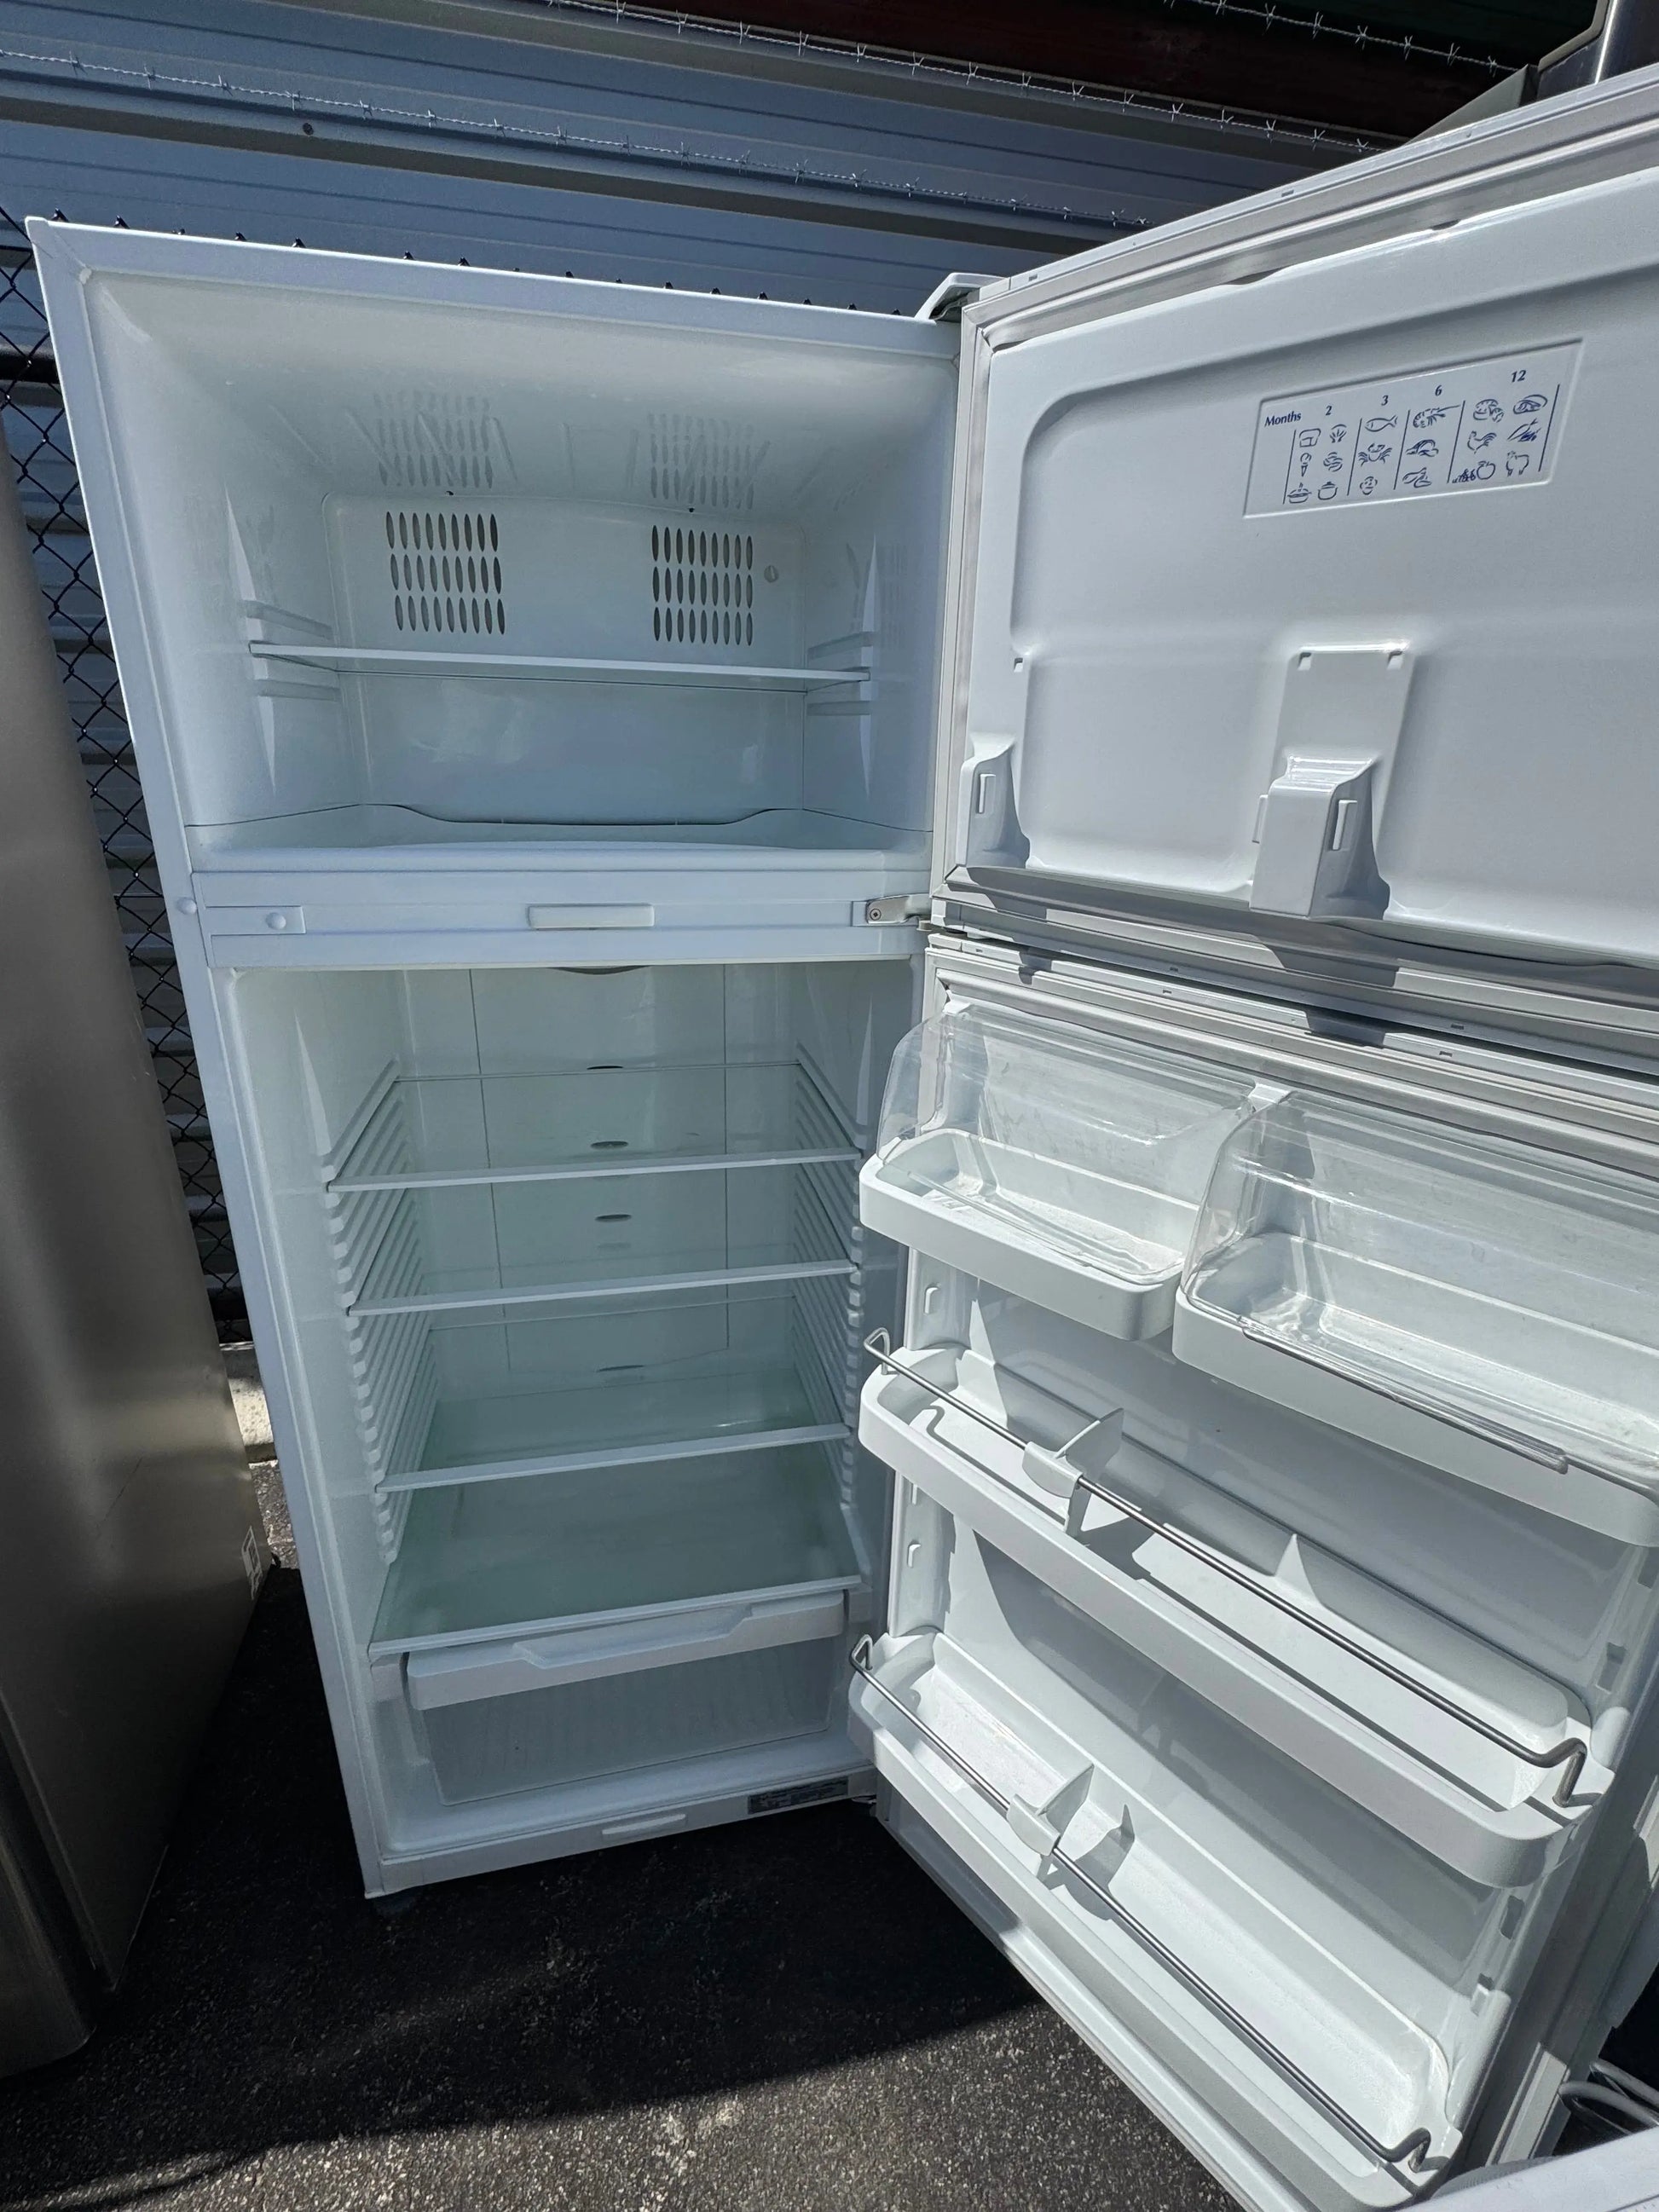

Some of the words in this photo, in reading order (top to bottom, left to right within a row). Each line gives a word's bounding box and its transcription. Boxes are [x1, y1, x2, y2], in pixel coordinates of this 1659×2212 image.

[1263, 411, 1302, 427] Months
[1325, 405, 1332, 416] 2
[1380, 394, 1390, 407] 3
[1434, 384, 1442, 396] 6
[1511, 369, 1527, 384] 12
